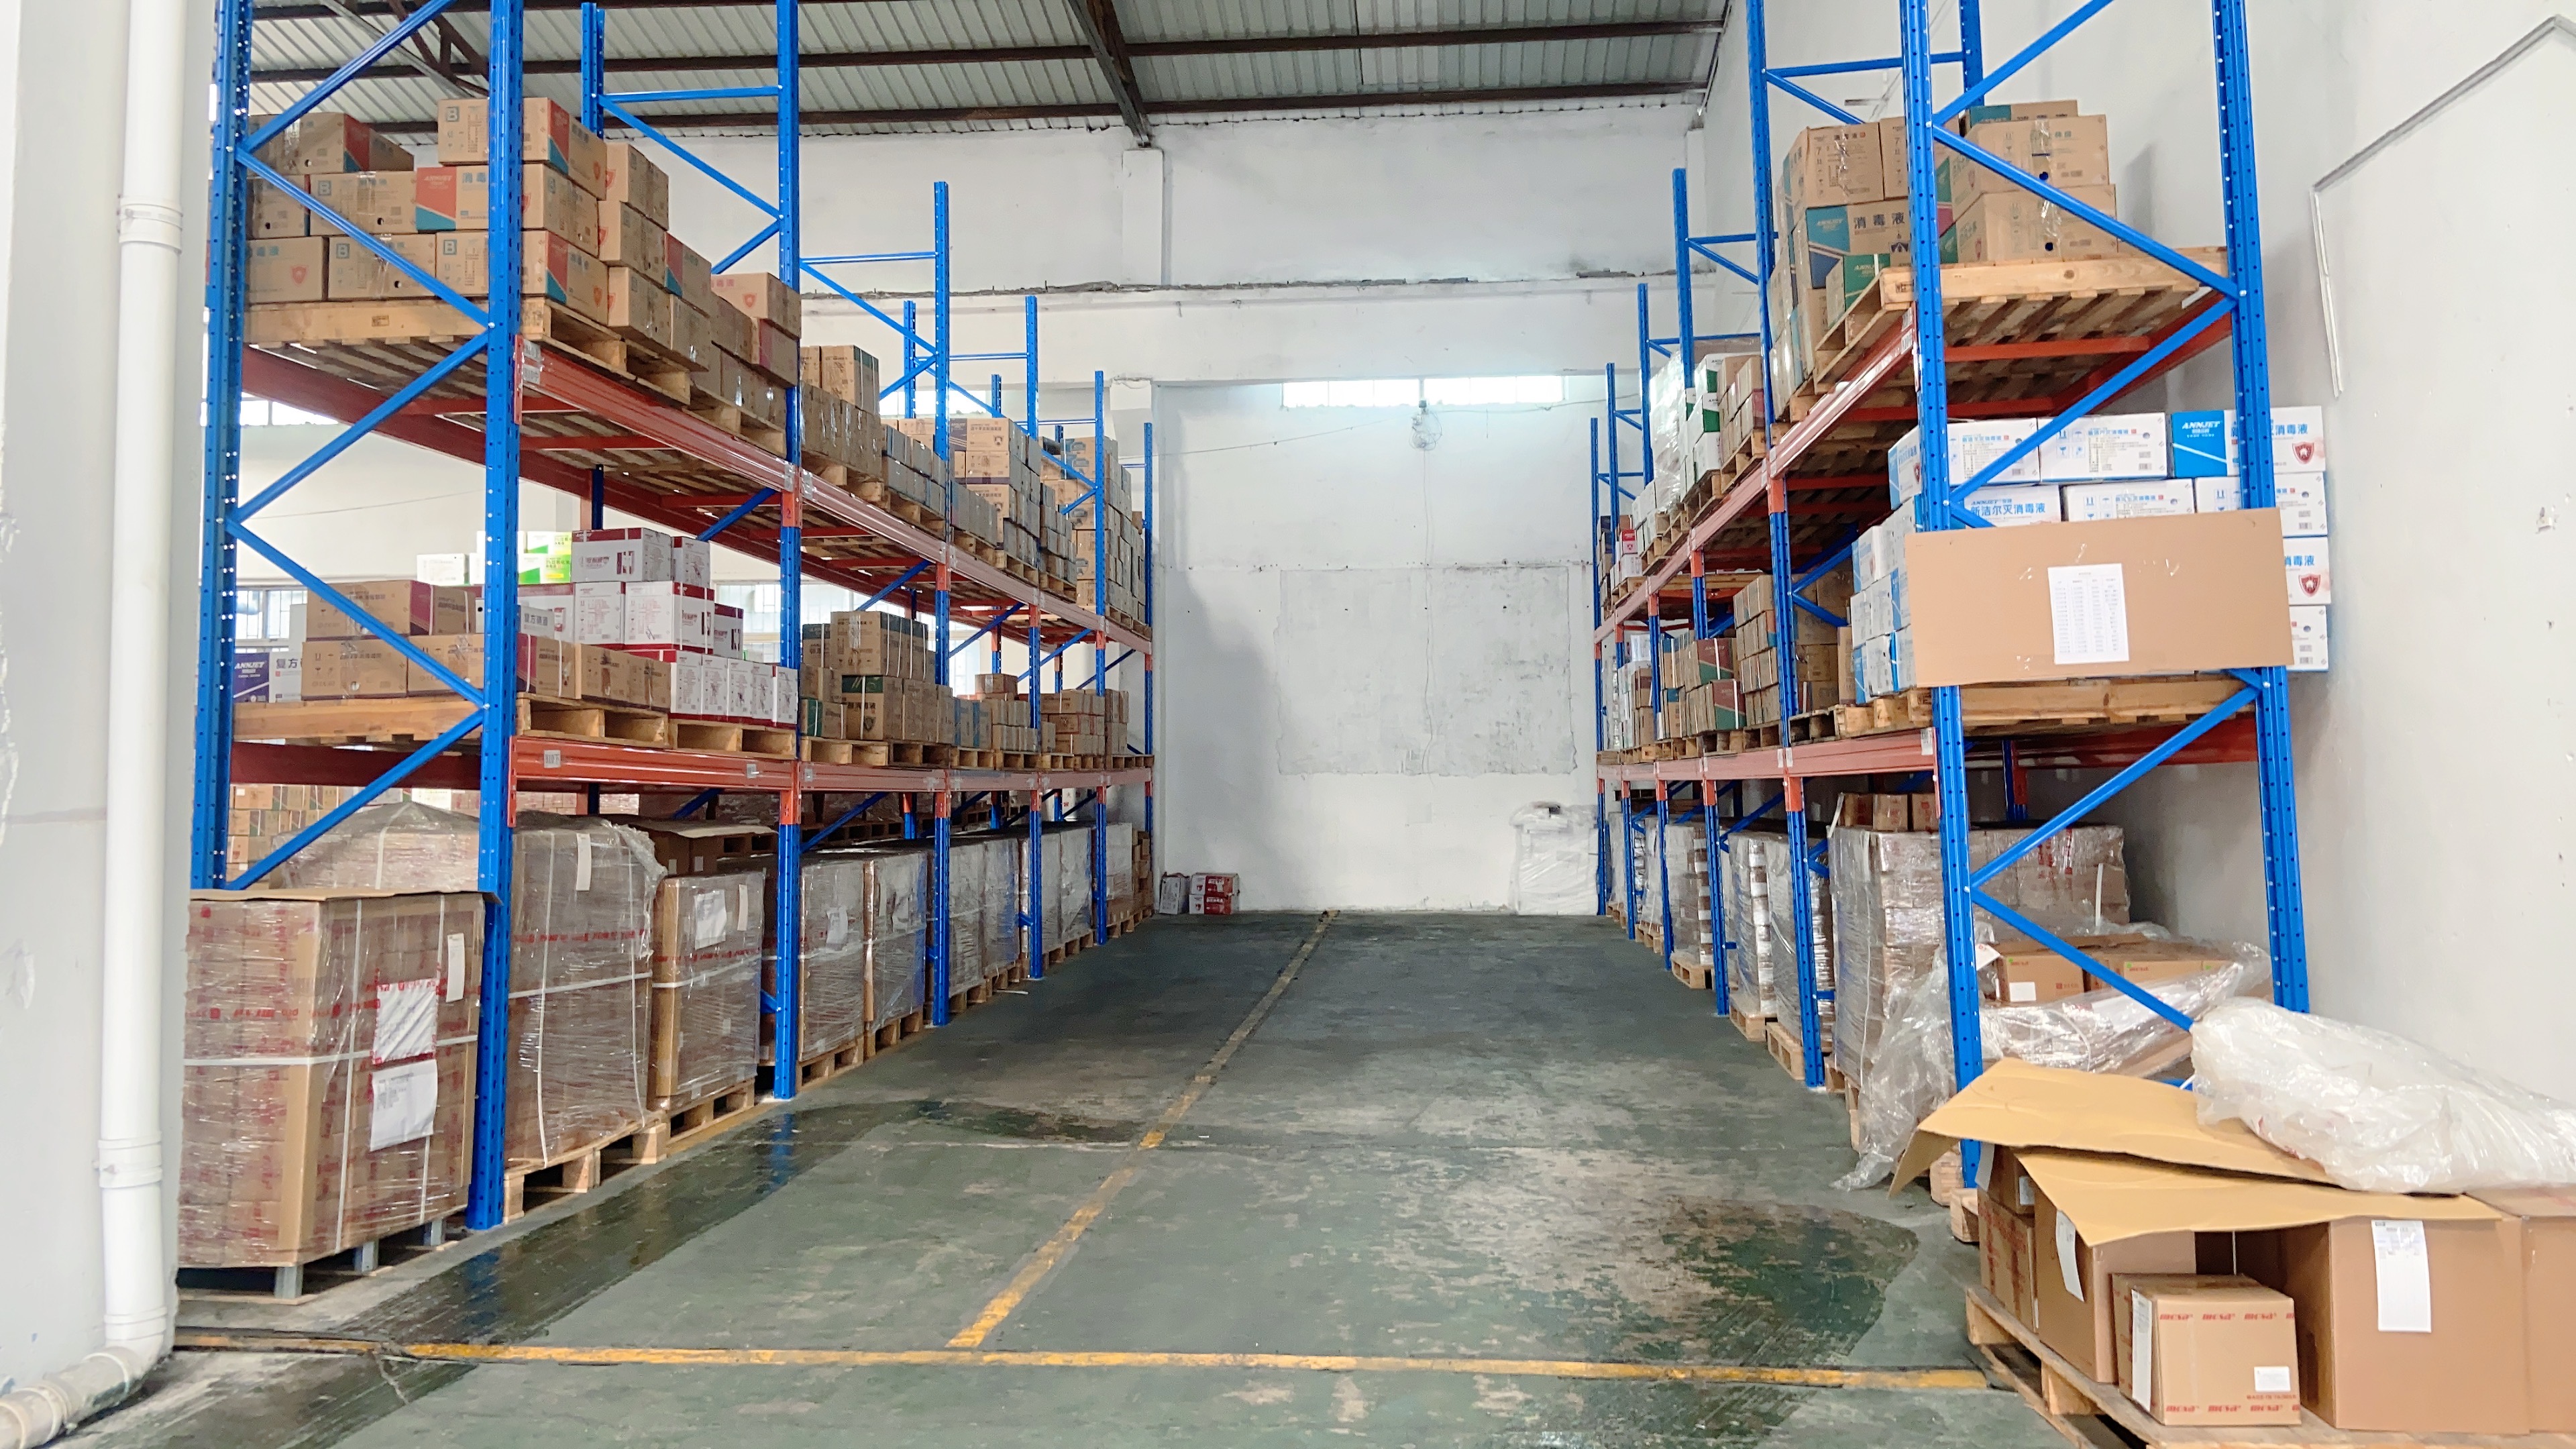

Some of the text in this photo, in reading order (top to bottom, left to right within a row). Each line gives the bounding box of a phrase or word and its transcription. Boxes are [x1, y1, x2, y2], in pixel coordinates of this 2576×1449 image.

[2182, 421, 2222, 429] ANNJET
[1971, 502, 2046, 516] 新洁尔灭消毒液
[276, 658, 303, 669] 复方
